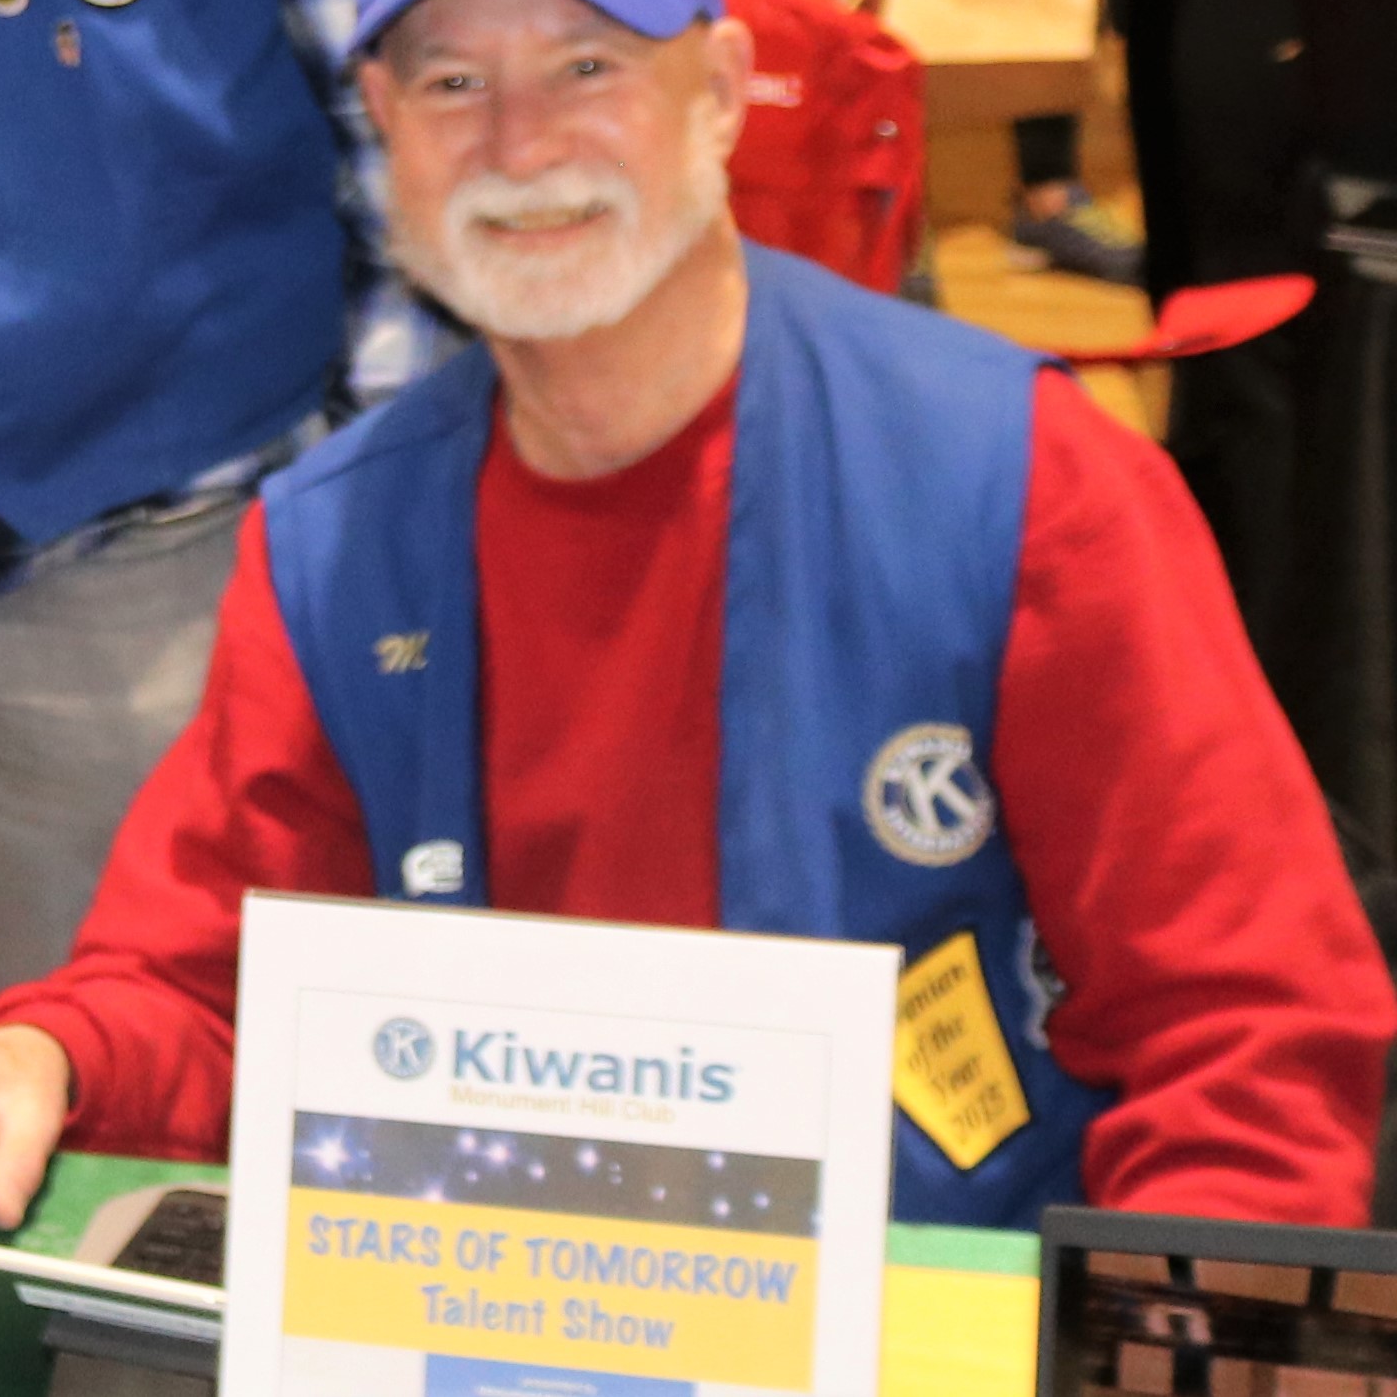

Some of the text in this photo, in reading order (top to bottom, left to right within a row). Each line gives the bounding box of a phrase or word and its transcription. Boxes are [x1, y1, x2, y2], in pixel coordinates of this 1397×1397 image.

[452, 1029, 738, 1103] Kiwanis
[307, 1213, 799, 1304] STARS OF TOMORROW
[421, 1283, 675, 1349] Talent Show
